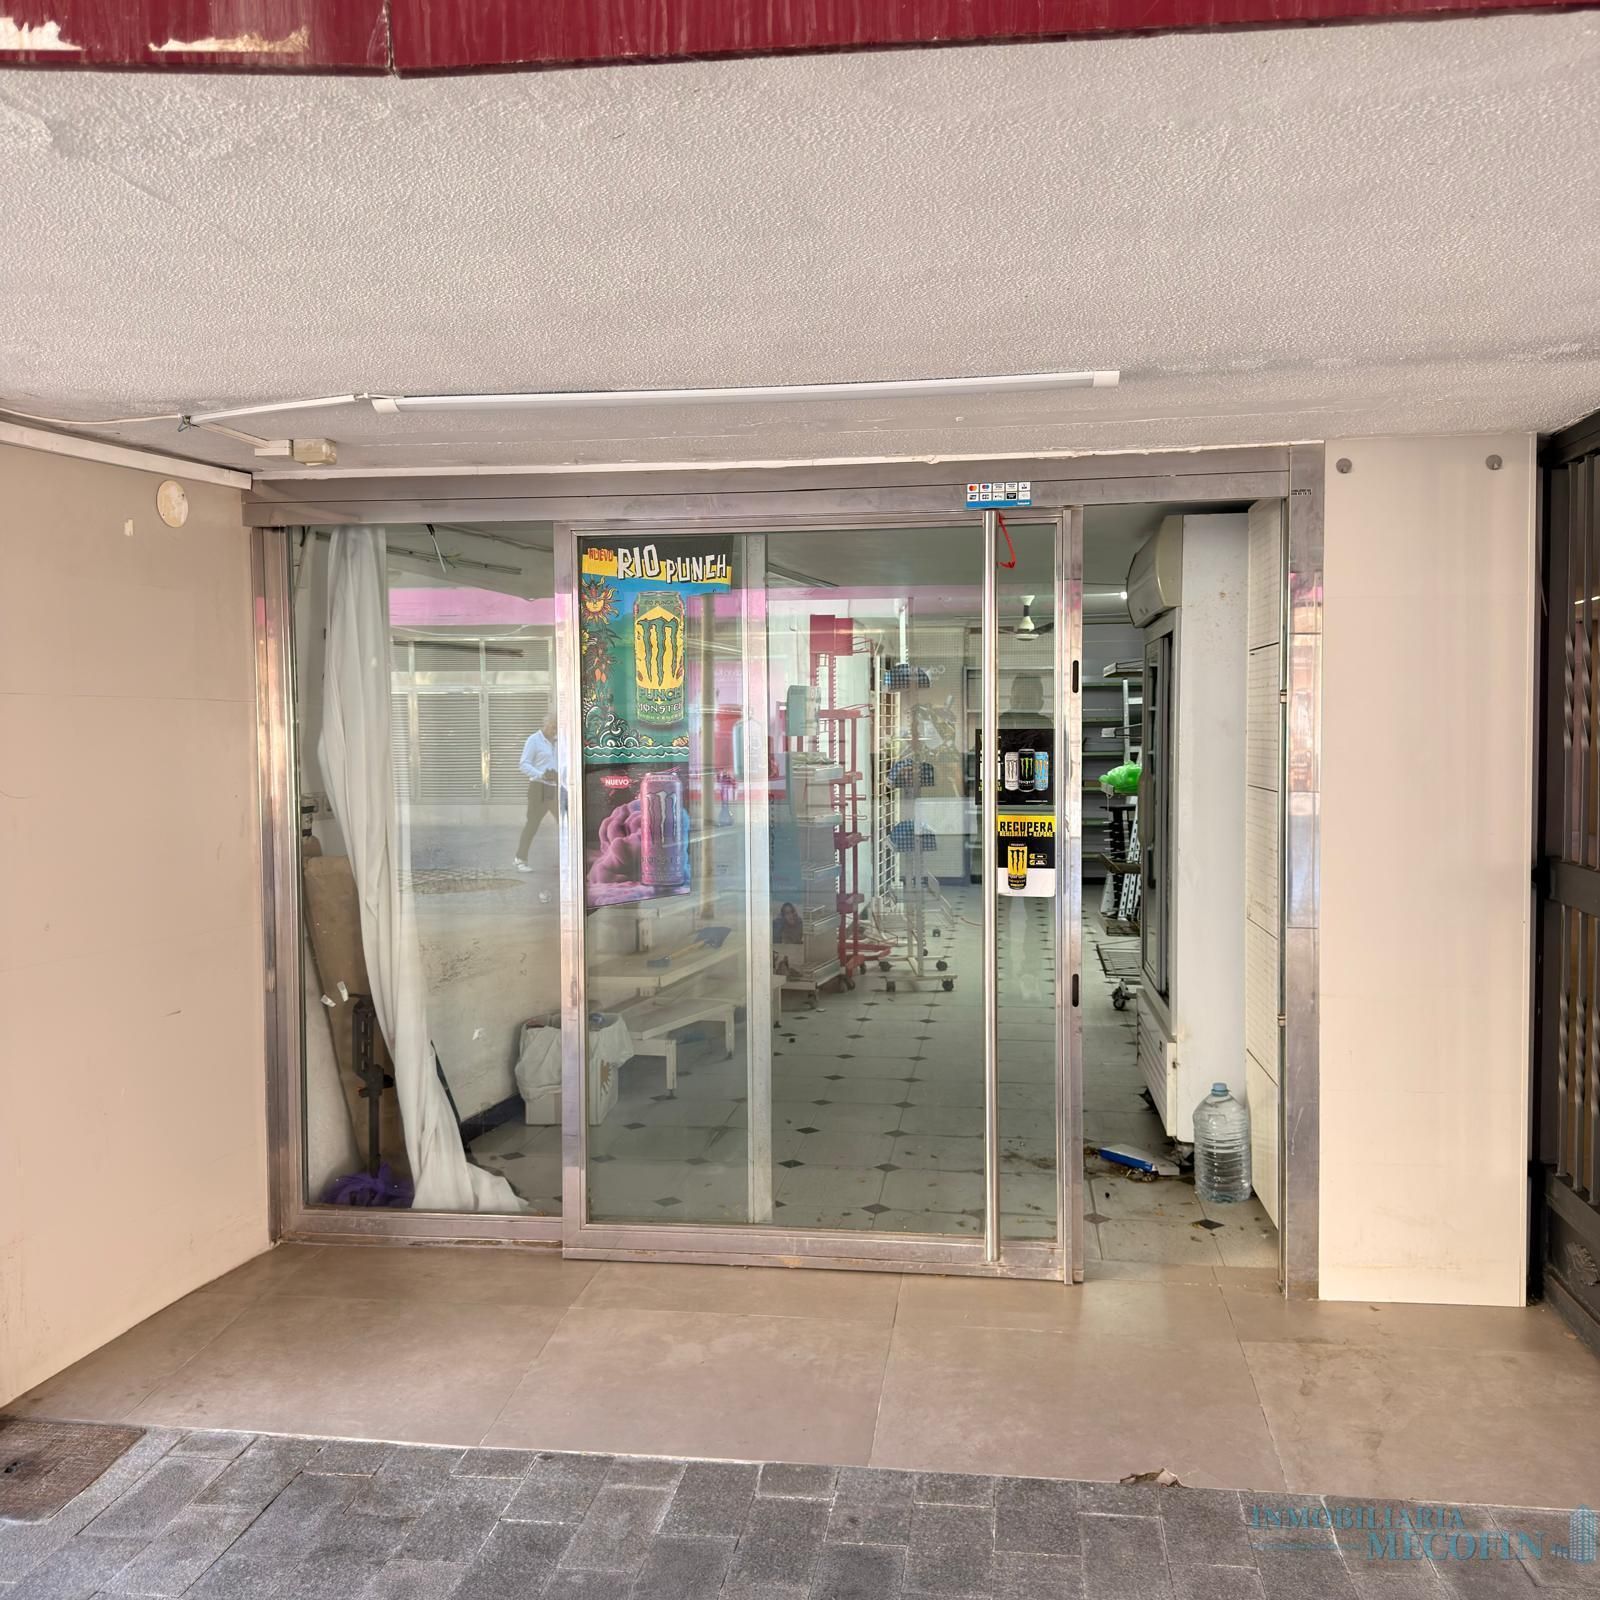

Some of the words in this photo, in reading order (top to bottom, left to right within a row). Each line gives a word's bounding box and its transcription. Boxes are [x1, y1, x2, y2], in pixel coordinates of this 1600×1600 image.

[587, 547, 613, 562] NUEVO
[617, 544, 660, 580] RIO
[666, 554, 726, 584] PUNCH
[1000, 821, 1053, 832] RECUPERA
